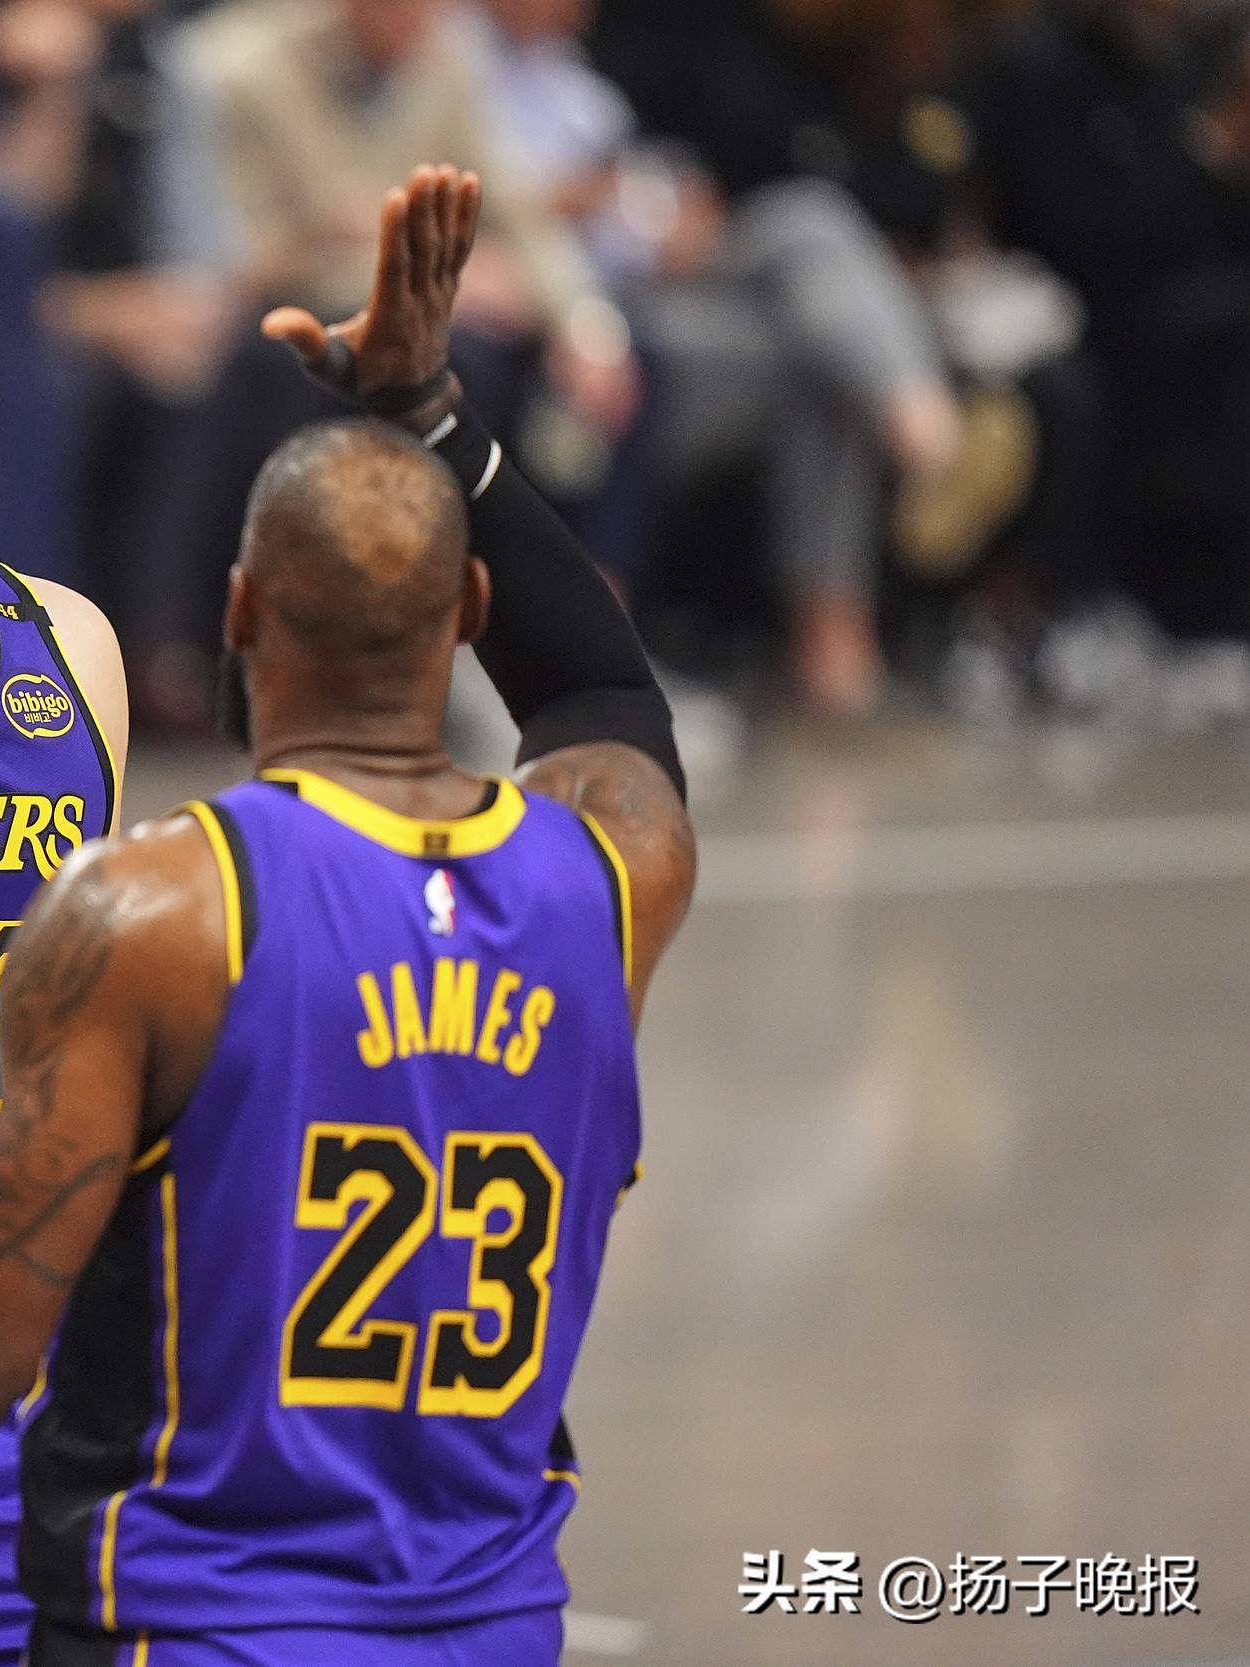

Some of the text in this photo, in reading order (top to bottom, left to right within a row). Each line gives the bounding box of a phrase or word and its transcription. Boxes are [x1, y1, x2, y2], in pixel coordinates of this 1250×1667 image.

[6, 689, 69, 718] bibigo
[356, 957, 556, 1077] JAMES
[278, 1121, 564, 1419] 23
